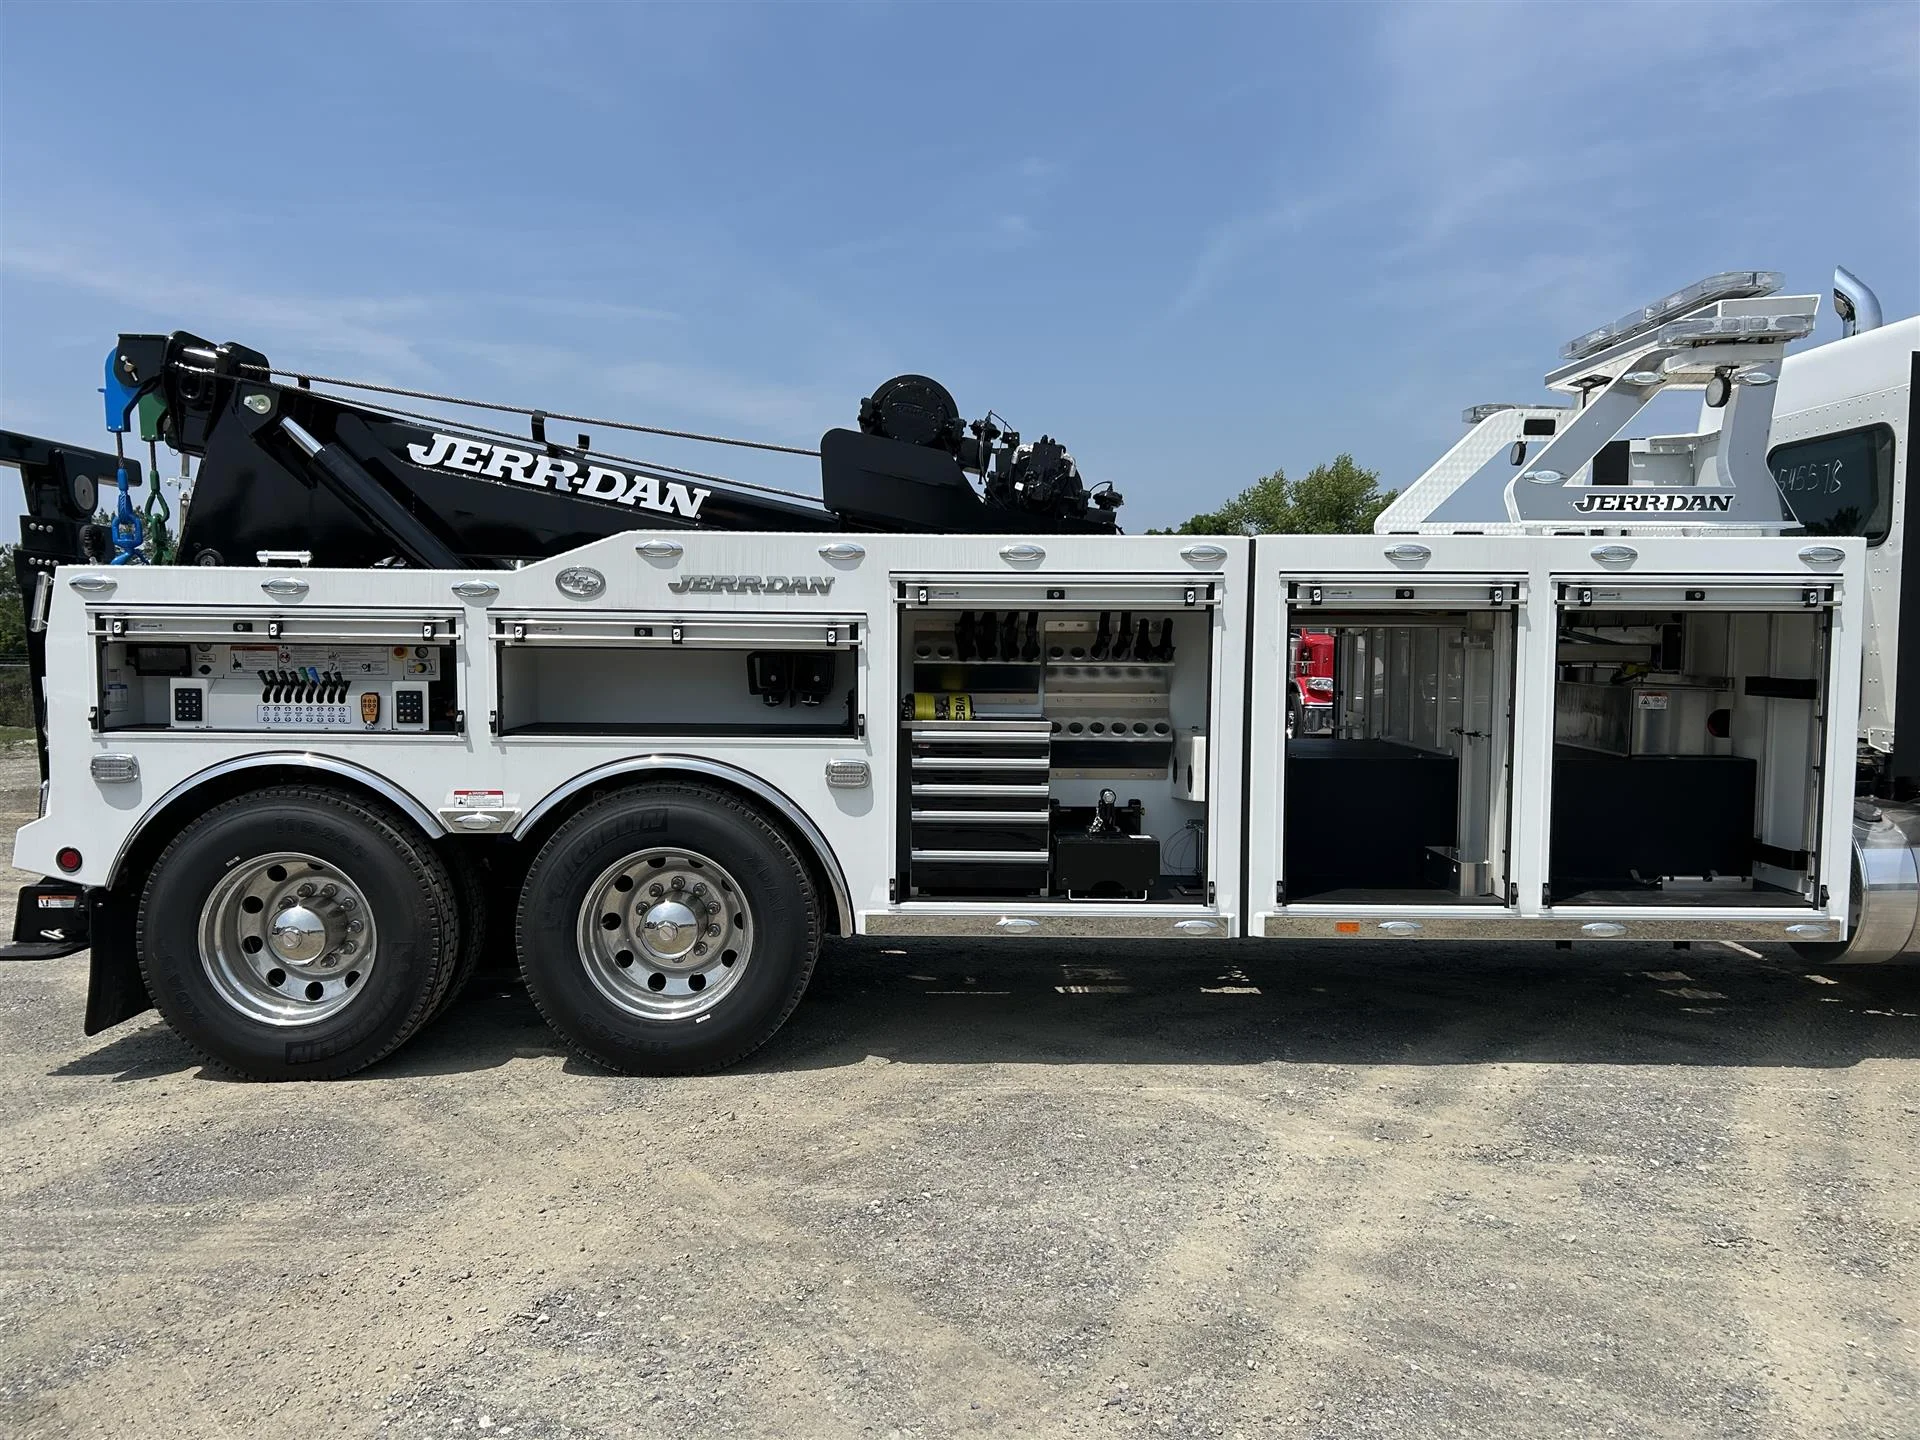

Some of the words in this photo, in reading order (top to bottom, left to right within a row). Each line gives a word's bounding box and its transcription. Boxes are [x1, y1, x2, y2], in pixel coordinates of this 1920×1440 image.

[407, 433, 712, 518] JERR-DAN
[1574, 494, 1734, 512] JERR-DAN
[668, 575, 835, 595] JERR-DAN
